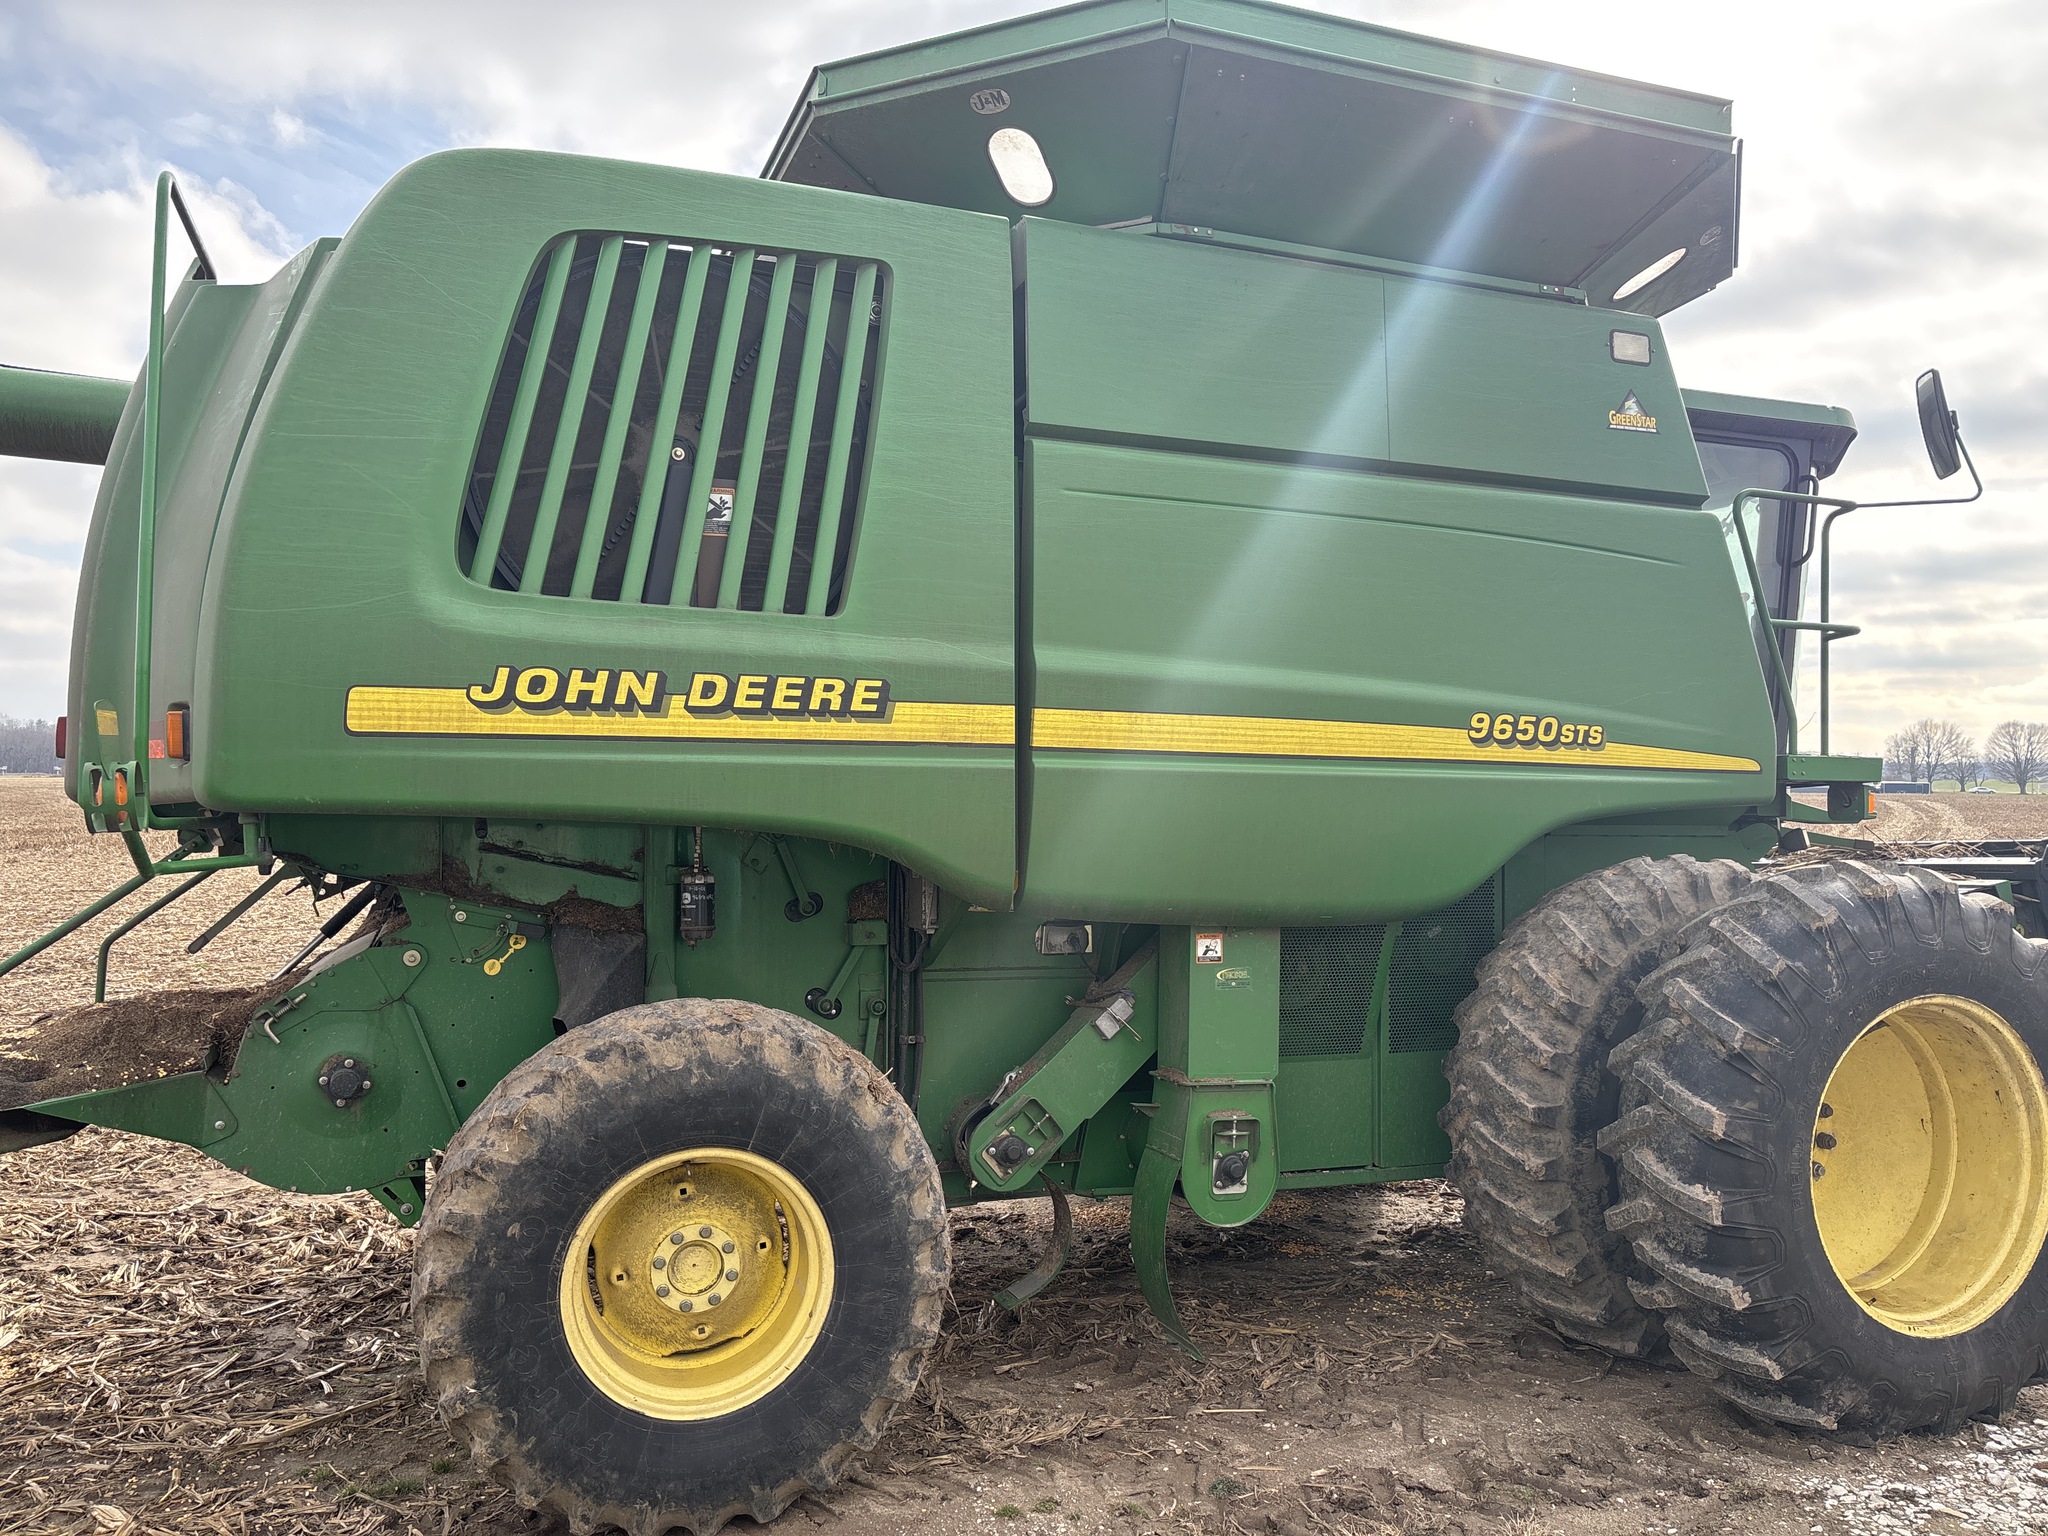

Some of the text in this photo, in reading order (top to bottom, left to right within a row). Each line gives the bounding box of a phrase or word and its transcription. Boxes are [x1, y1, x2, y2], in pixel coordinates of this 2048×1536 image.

[973, 90, 1007, 110] J&M
[467, 665, 887, 717] JOHN DEERE
[1468, 711, 1605, 747] 9650STS
[848, 1242, 903, 1395] TRACTION
